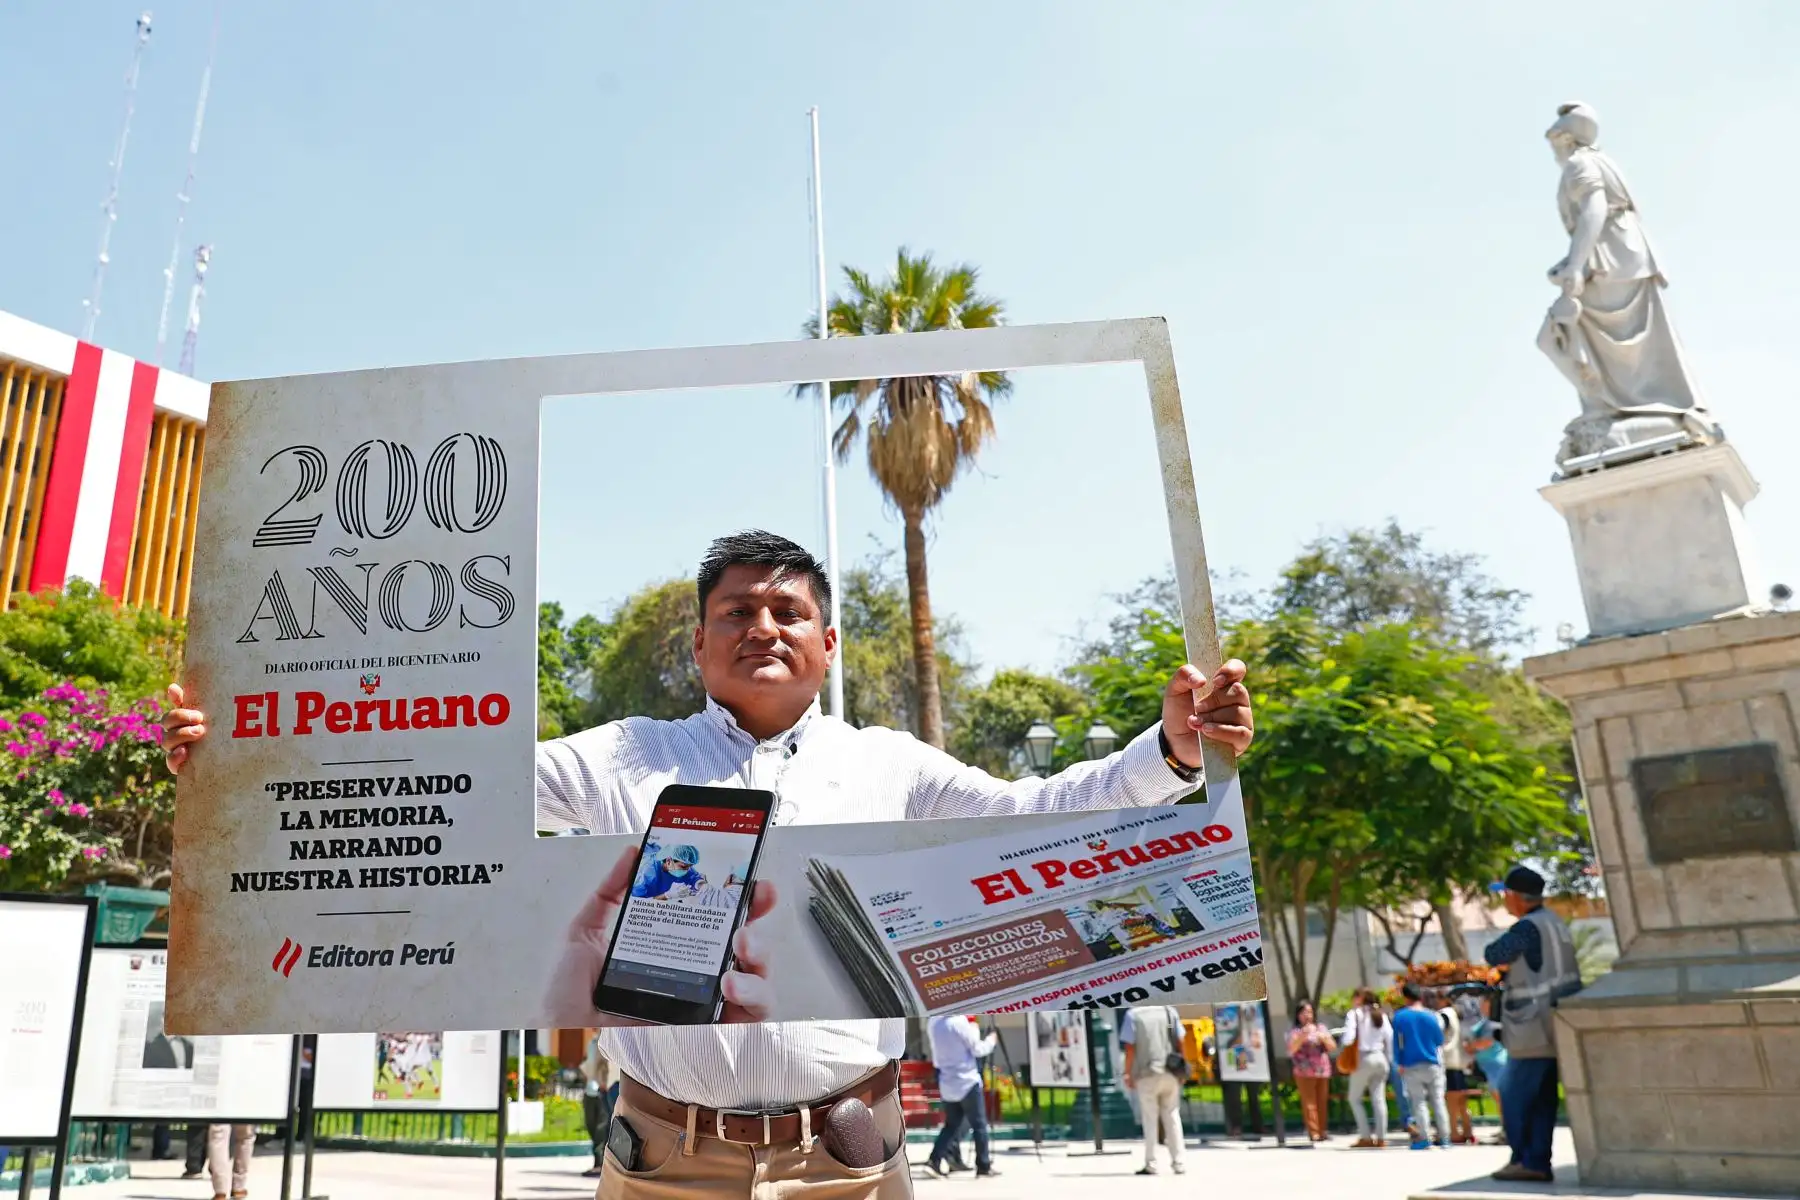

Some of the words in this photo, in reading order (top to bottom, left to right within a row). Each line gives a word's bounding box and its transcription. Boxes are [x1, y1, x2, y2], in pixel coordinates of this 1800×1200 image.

[253, 433, 507, 547] 200
[236, 548, 515, 643] AÑOS
[264, 661, 308, 674] DIARIO
[309, 658, 359, 671] OFICIAL
[361, 657, 385, 668] DEL
[387, 652, 481, 667] BICENTENARIO
[232, 691, 280, 739] El
[293, 691, 510, 736] Peruano
[264, 774, 472, 801] “PRESERVANDO
[280, 810, 315, 831] LA
[320, 805, 454, 829] MEMORIA,
[682, 818, 717, 827] Peruano
[289, 835, 442, 860] NARRANDO
[230, 868, 354, 892] NUESTRA
[359, 863, 503, 888] HISTORIA”
[970, 868, 1034, 906] El
[1031, 823, 1233, 889] Peruano
[1193, 885, 1222, 898] logra
[629, 913, 660, 922] agencias
[675, 919, 699, 927] Banco
[630, 906, 656, 915] puntos
[668, 912, 712, 922] vacunación
[633, 899, 655, 908] Minsa
[656, 901, 693, 913] habilitará
[695, 908, 727, 917] mañana
[627, 919, 652, 928] Nación
[307, 945, 393, 968] Editora
[400, 942, 455, 966] Perú
[911, 920, 1046, 965] COLECCIONES
[916, 961, 949, 979] EN
[950, 928, 1068, 969] EXHIBICIÓN
[1031, 982, 1088, 1006] DISPONE
[1147, 959, 1165, 971] DE
[1165, 943, 1218, 965] PUENTES
